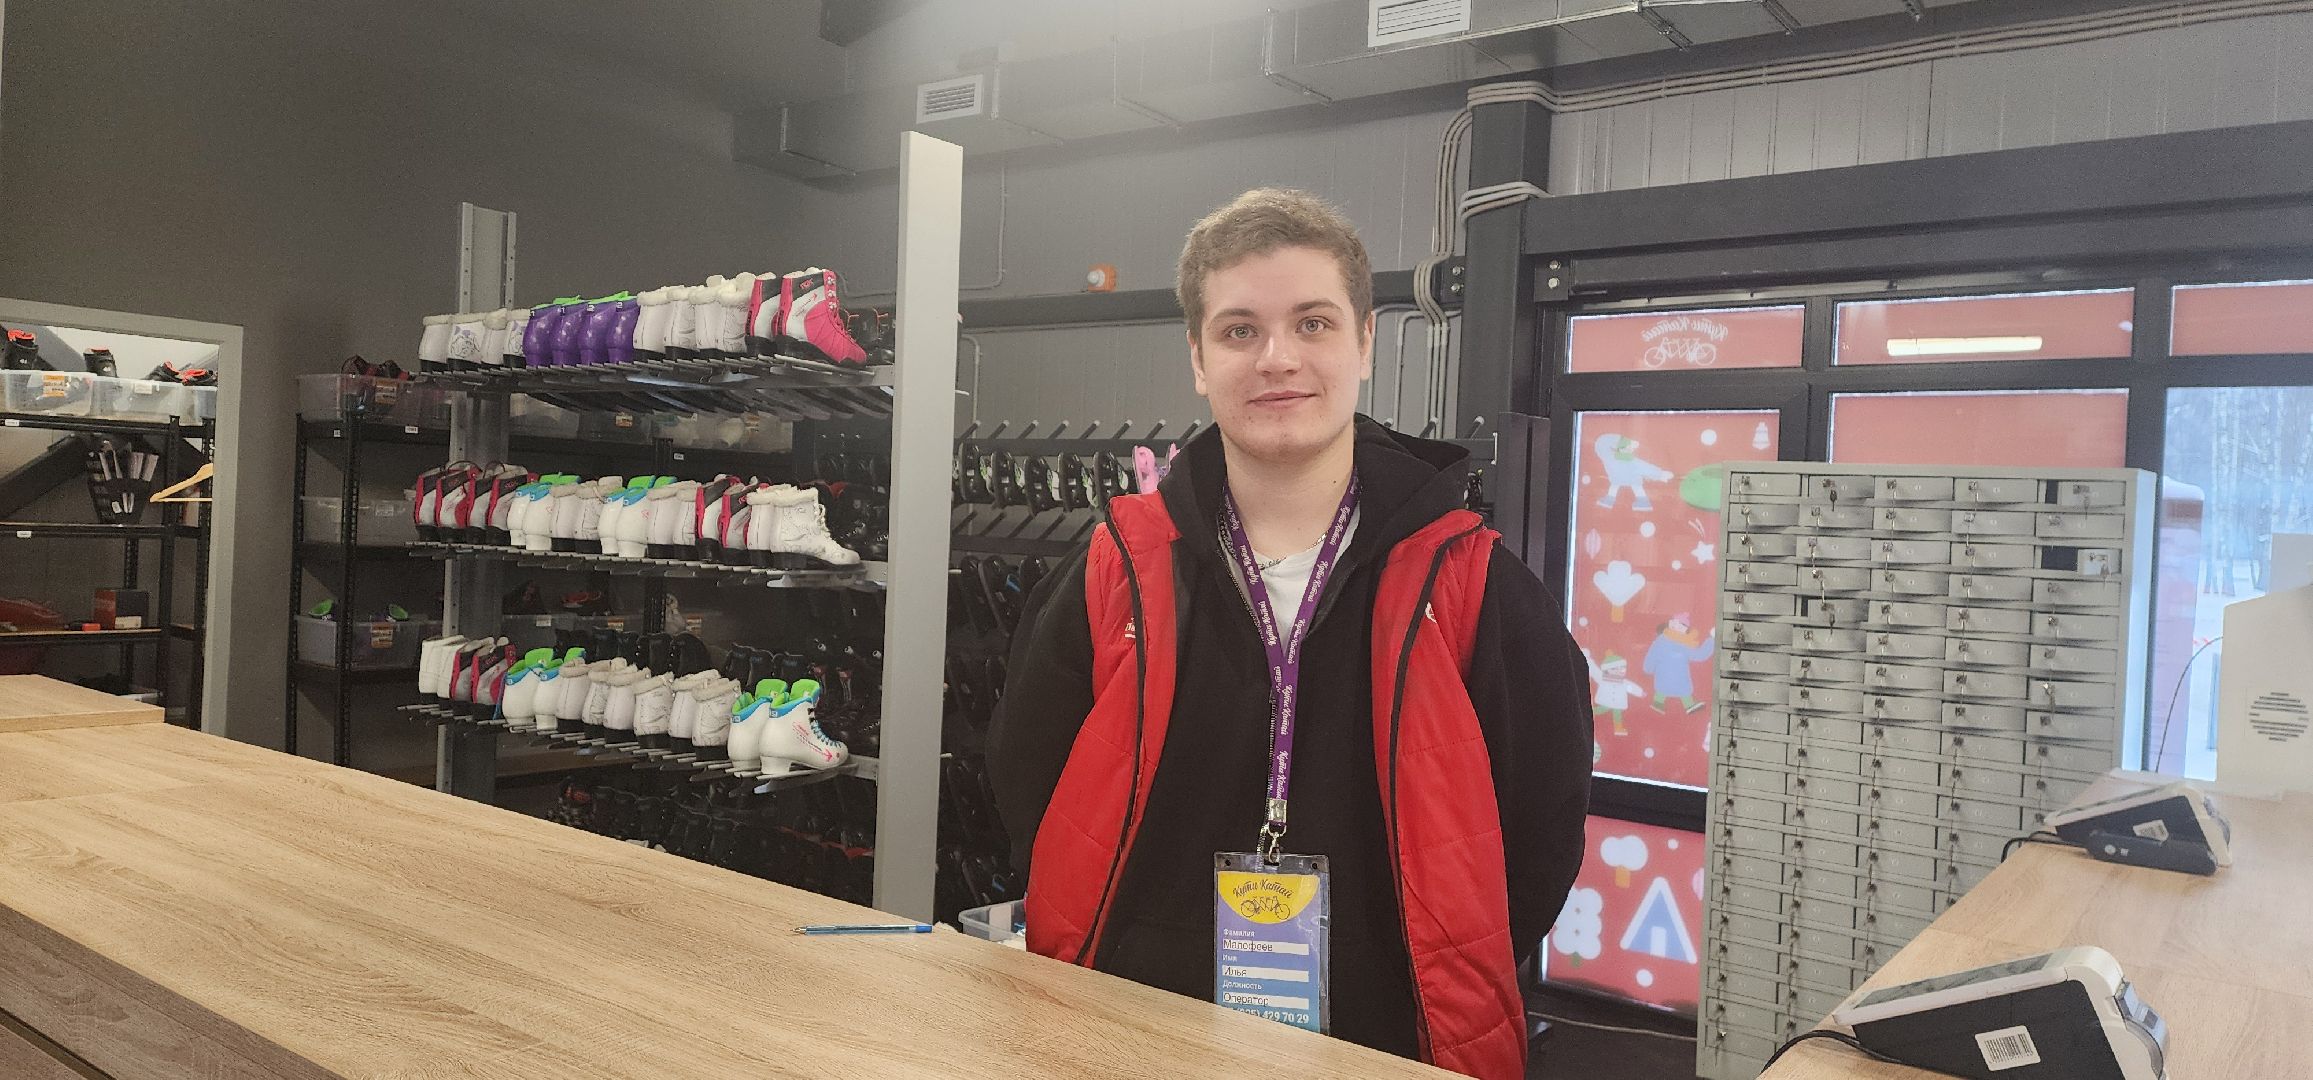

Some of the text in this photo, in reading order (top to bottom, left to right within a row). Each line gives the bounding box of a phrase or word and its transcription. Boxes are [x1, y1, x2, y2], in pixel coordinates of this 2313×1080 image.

[1223, 929, 1255, 937] Фамилия
[1224, 940, 1272, 952] Малофеев
[1223, 954, 1237, 962] Имя
[1223, 980, 1262, 990] Должность
[1224, 992, 1268, 1007] Оператор
[1282, 1012, 1295, 1022] 70
[1297, 1014, 1309, 1023] 29
